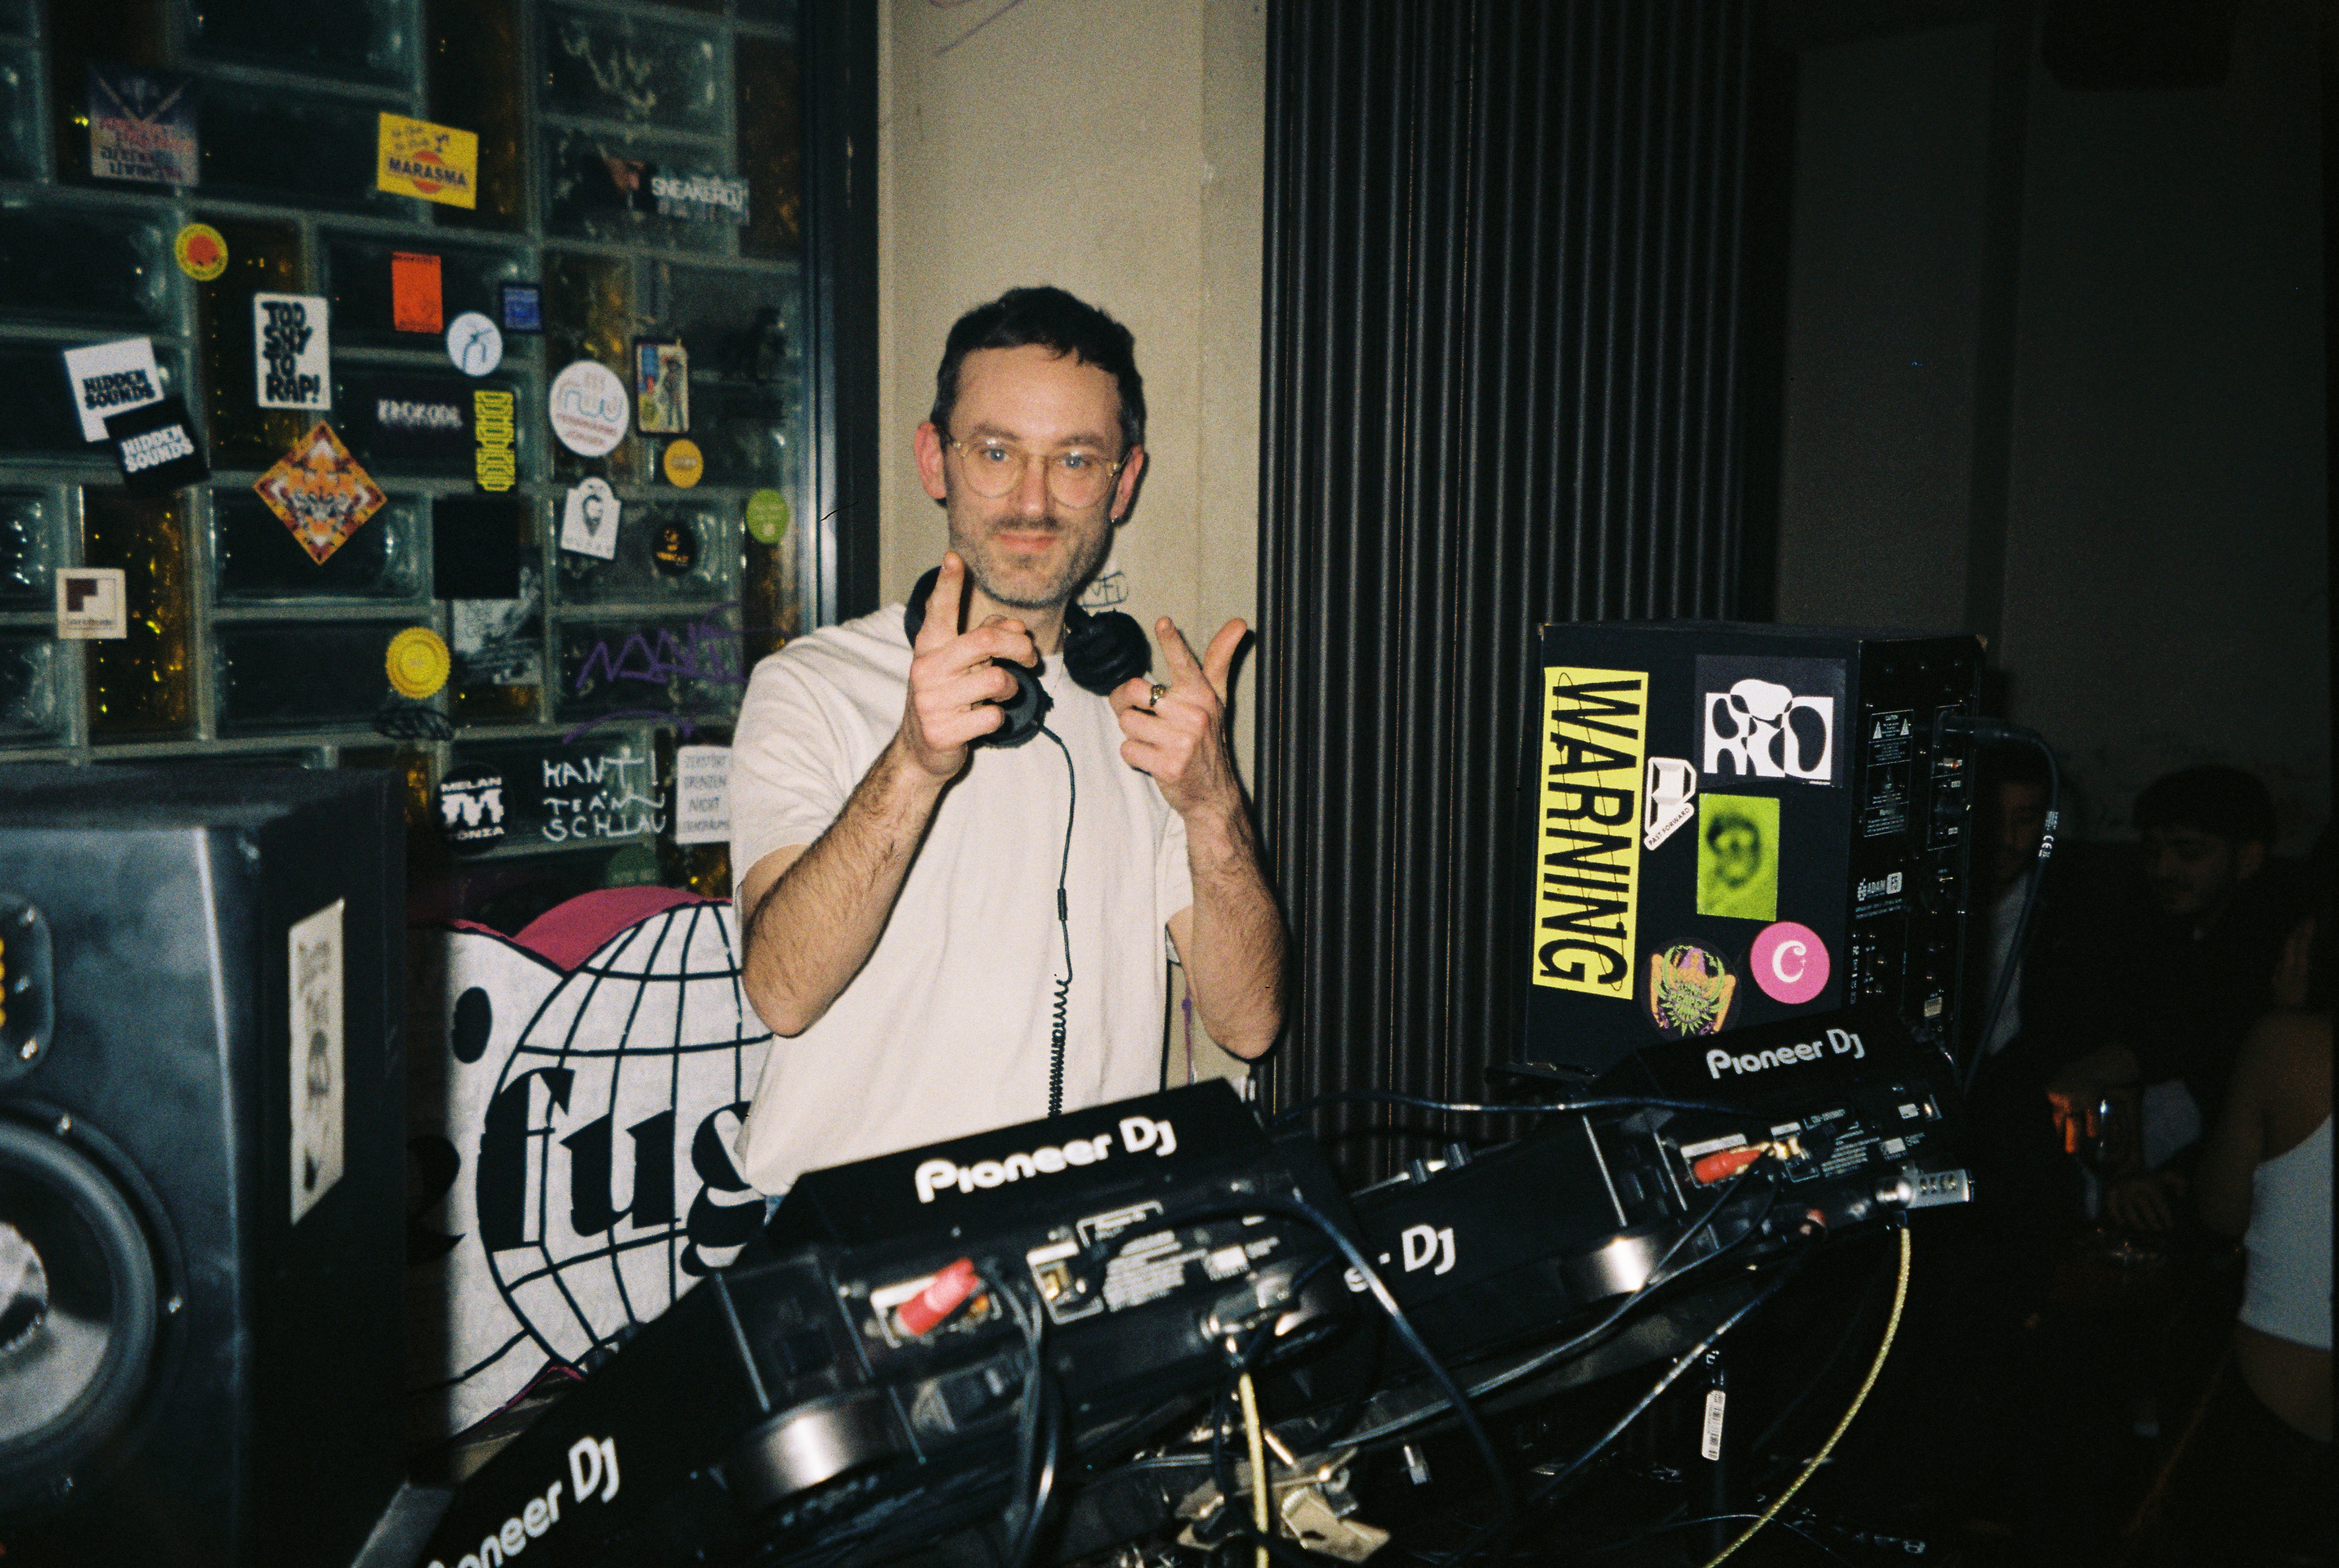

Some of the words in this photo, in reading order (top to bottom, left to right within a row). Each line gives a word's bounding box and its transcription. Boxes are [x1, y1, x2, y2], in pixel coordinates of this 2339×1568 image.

[261, 301, 306, 326] TOO
[263, 325, 314, 355] SHY
[84, 385, 156, 410] SOUNDS
[124, 441, 194, 473] SOUNDS
[1538, 679, 1642, 986] WARNING
[1648, 831, 1663, 846] PAST
[1662, 807, 1691, 834] FORWARD
[1705, 1042, 1824, 1079] Pioneer
[915, 1133, 1114, 1204] Pioneer
